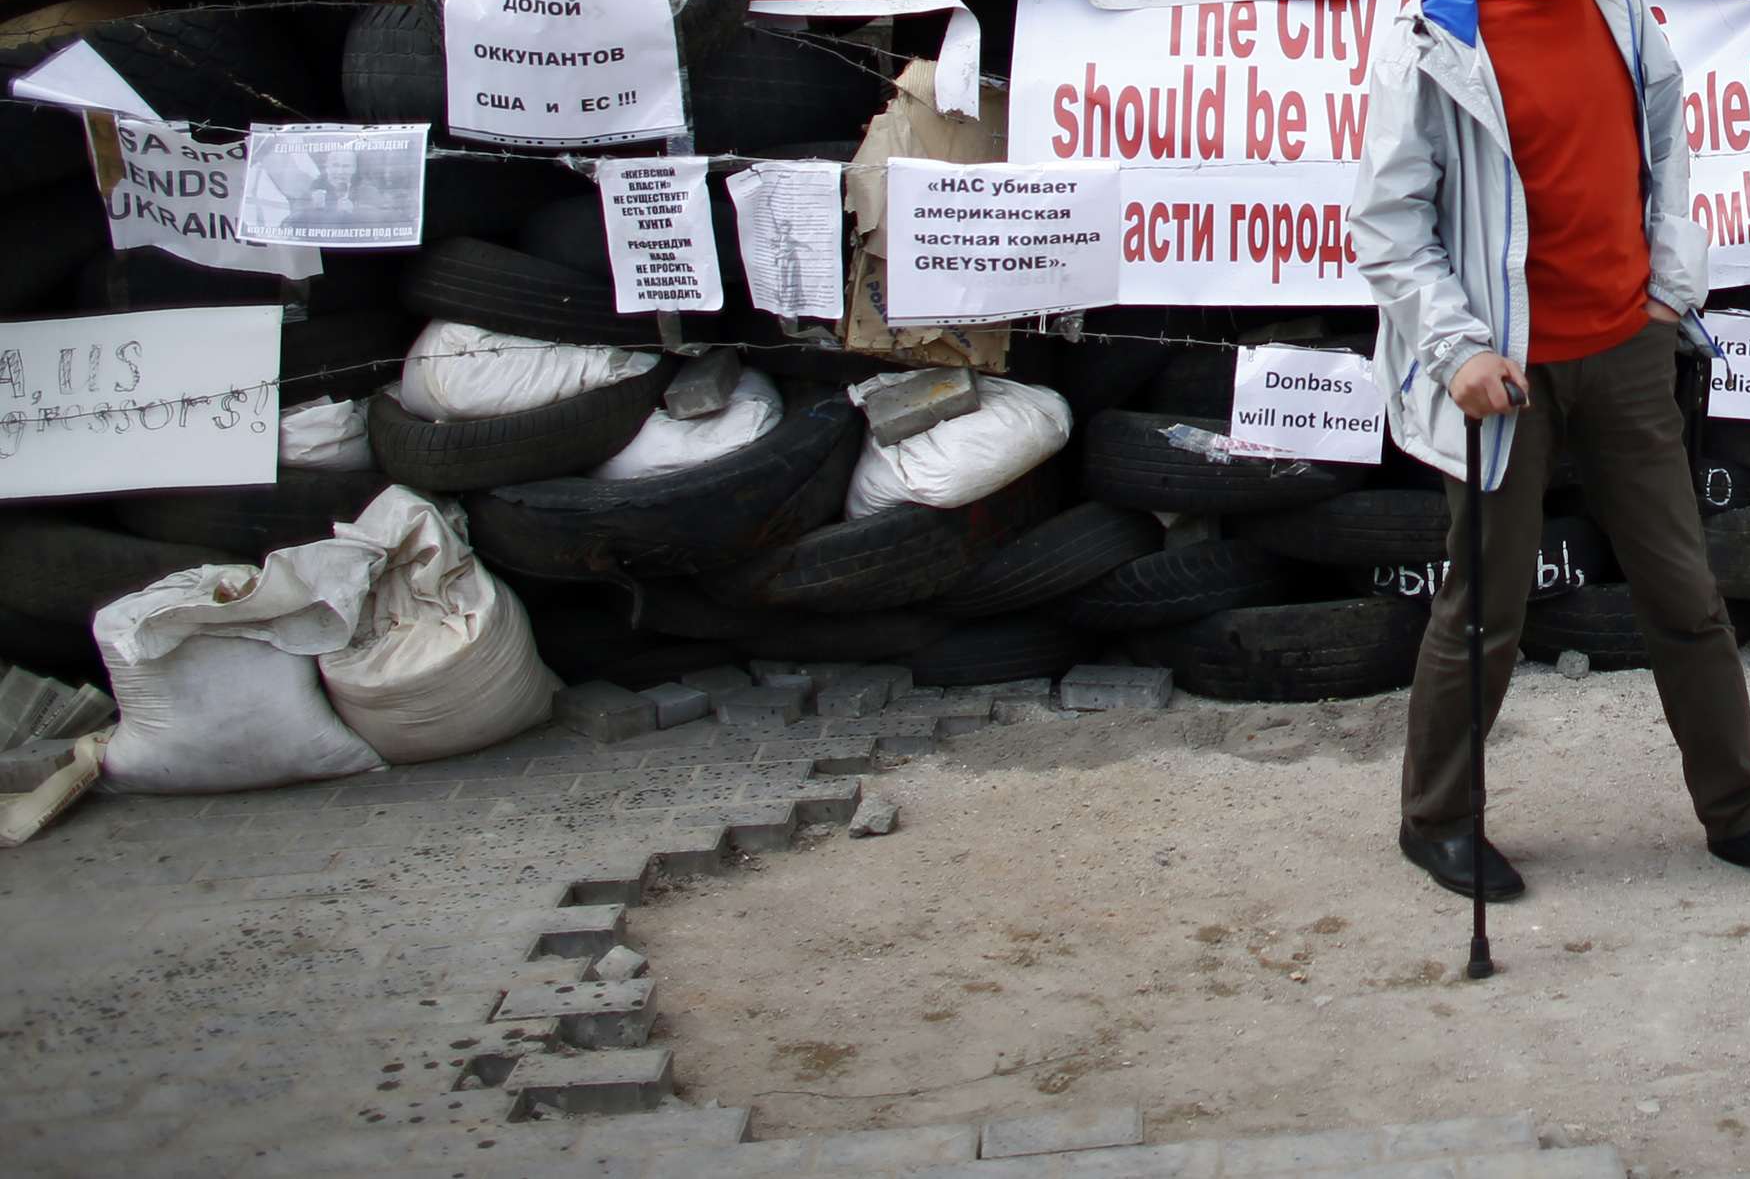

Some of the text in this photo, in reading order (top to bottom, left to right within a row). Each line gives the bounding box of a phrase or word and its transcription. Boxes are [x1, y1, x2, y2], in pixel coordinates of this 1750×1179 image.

[474, 43, 625, 67] ОККУПАНТОВ
[476, 91, 526, 112] США
[546, 101, 559, 113] и
[581, 96, 611, 112] ЕС
[1052, 62, 1307, 160] should be
[120, 126, 172, 156] SA
[927, 177, 1078, 197] «НАС убивает
[613, 195, 625, 205] НЕ
[622, 204, 683, 216] ЕСТЬ ТОЛЬКО
[913, 205, 1072, 222] американская
[108, 192, 267, 247] UKRAIN
[638, 218, 673, 230] ХУНТА
[628, 237, 692, 250] РЕФЕРЕНДУМ
[913, 228, 1102, 249] частная команда
[650, 252, 676, 262] НАДО
[914, 255, 1068, 273] GREYSTONE».
[636, 263, 648, 274] НЕ
[644, 275, 698, 287] НАЗНАЧАТЬ
[647, 289, 702, 300] ПРОВОДИТЬ
[1265, 371, 1353, 396] Donbass
[1239, 407, 1381, 435] will not kneel
